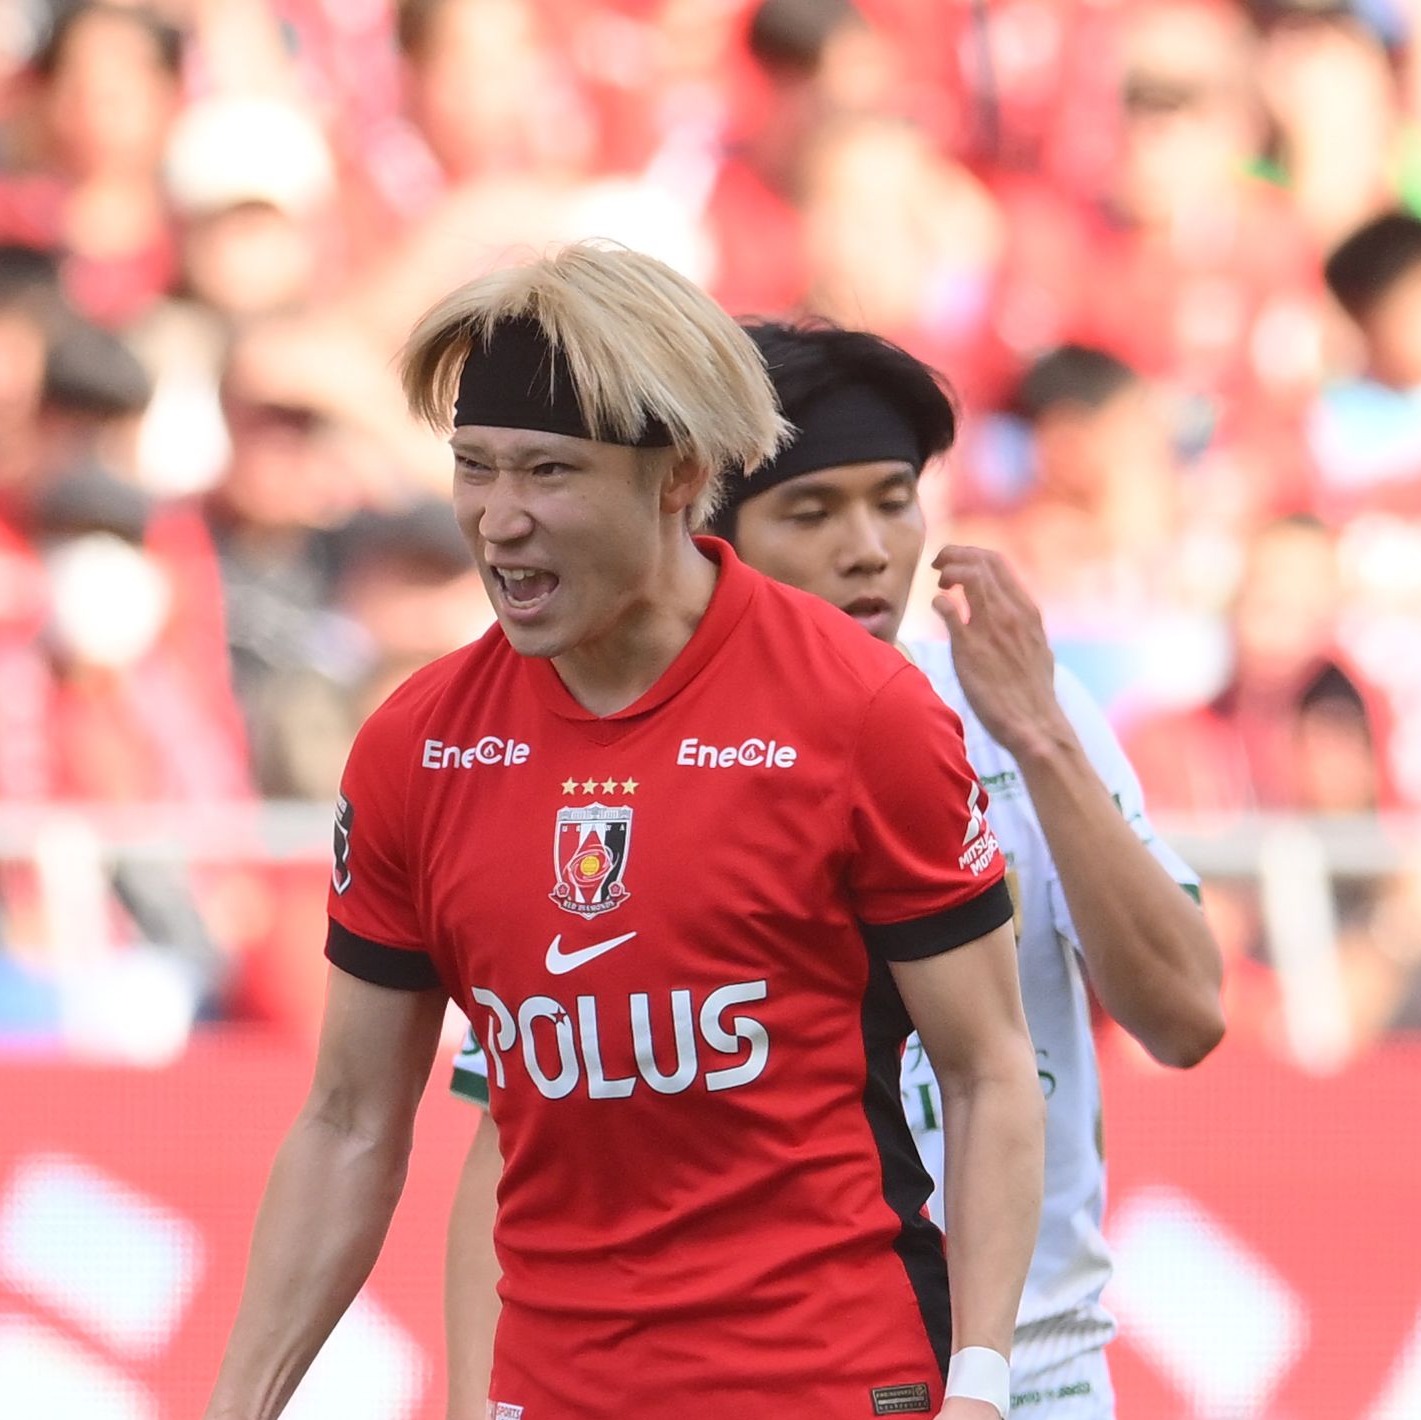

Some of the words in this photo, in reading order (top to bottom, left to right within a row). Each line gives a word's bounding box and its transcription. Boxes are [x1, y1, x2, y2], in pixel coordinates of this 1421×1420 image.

[422, 736, 531, 769] EneCle
[676, 737, 797, 769] EneCle
[472, 980, 771, 1101] POLUS
